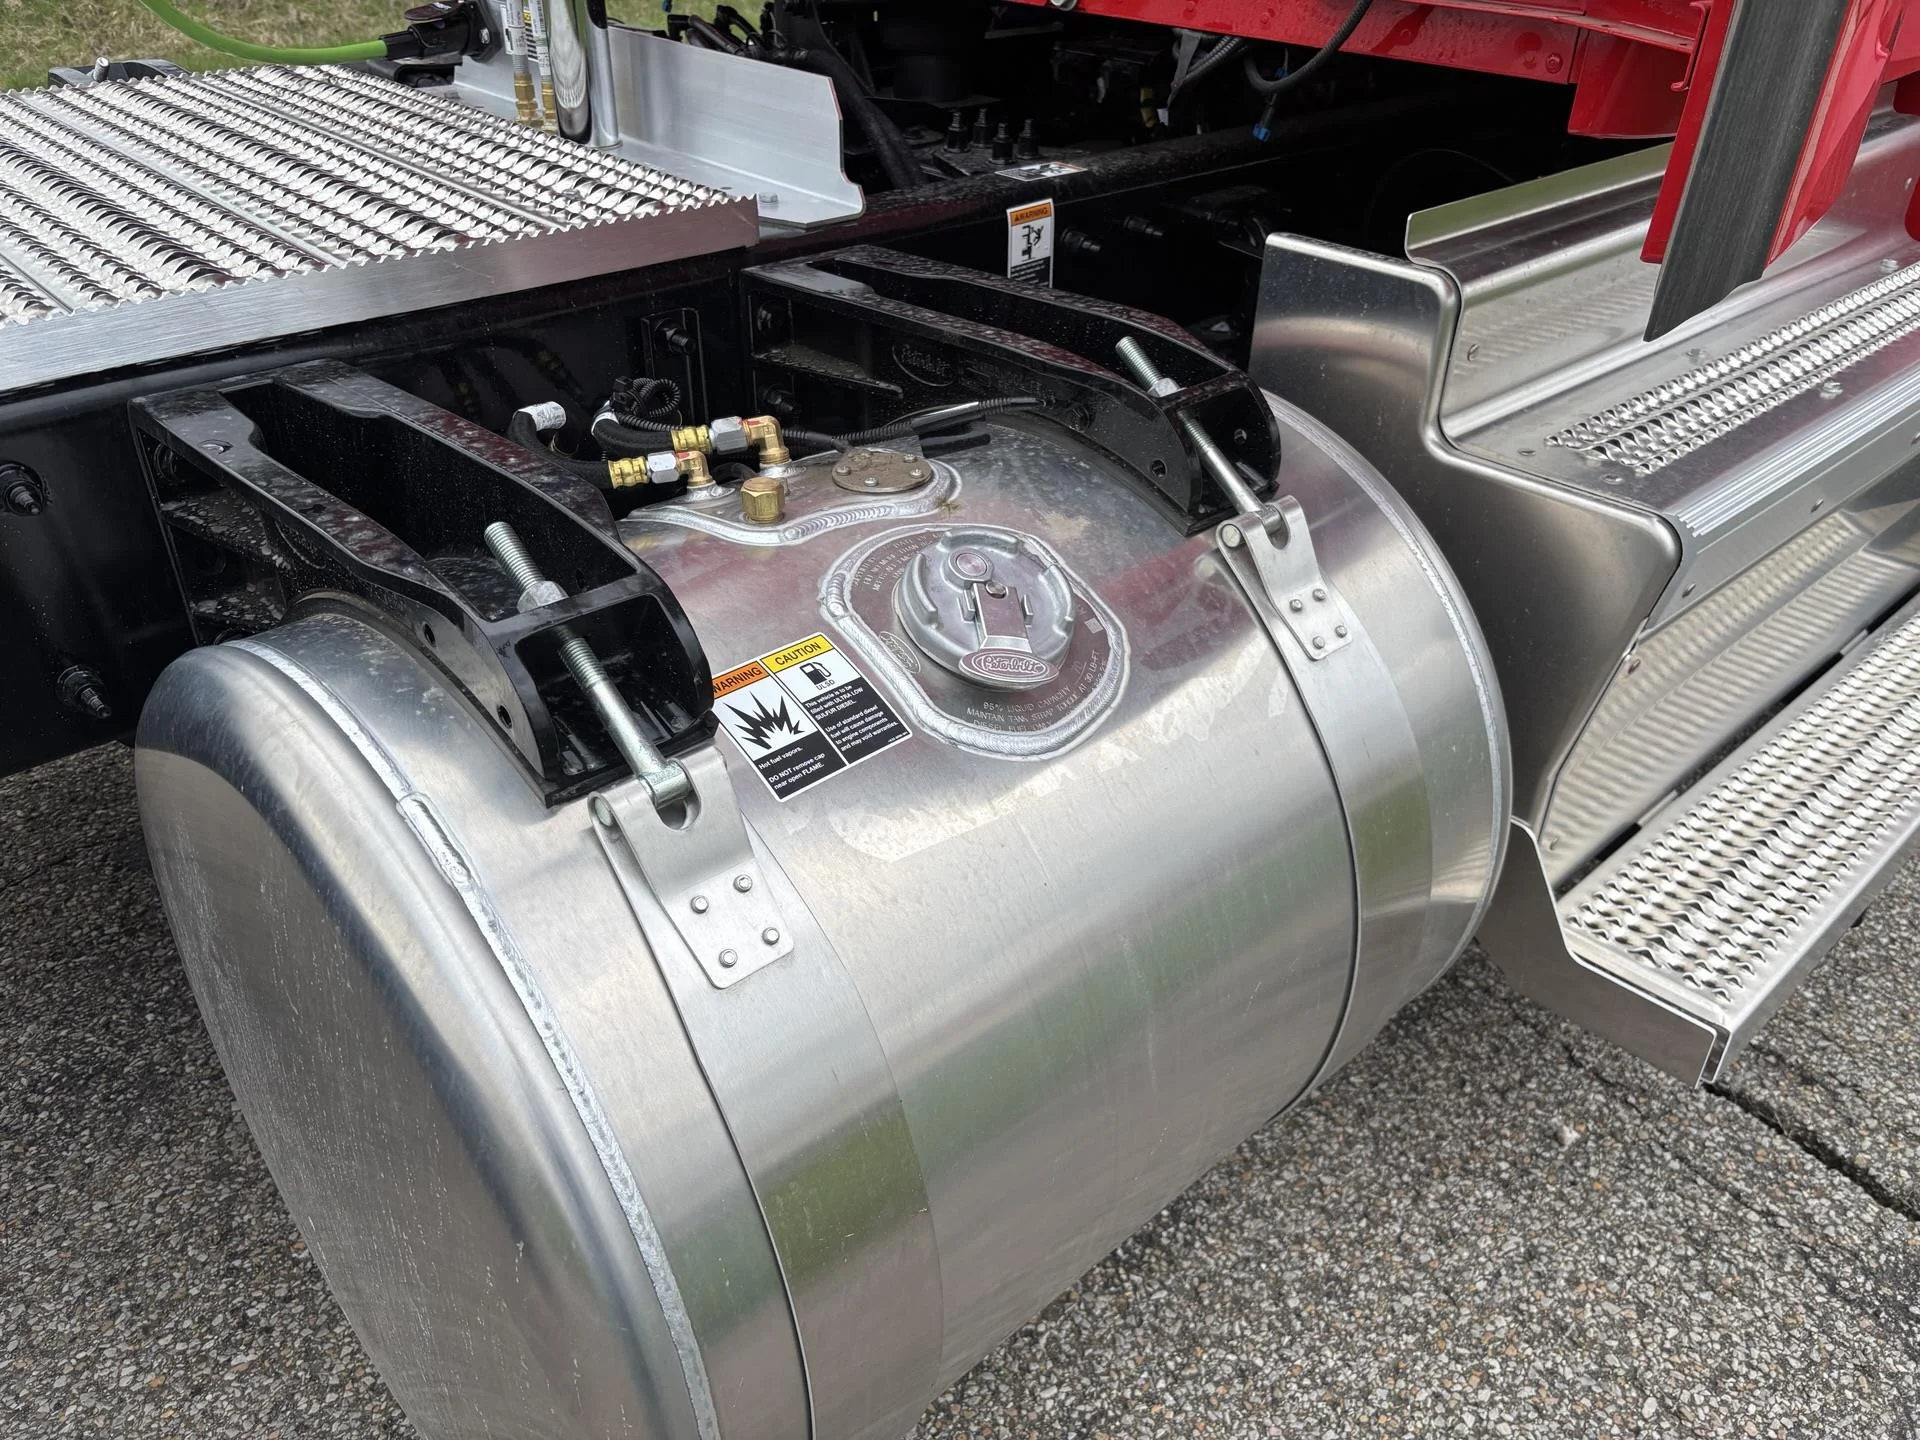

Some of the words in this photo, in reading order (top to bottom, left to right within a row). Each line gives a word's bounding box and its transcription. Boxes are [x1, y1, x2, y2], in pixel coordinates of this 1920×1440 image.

[774, 641, 822, 665] CAUTION
[981, 655, 1040, 673] Peterbilt
[815, 679, 835, 690] ULSD
[817, 693, 835, 703] vehicle
[823, 700, 835, 709] with
[833, 692, 853, 704] ULTRA
[850, 687, 864, 696] LOW
[1007, 703, 1034, 713] LIQUID
[815, 707, 837, 720] SULFUR
[842, 711, 864, 725] standard
[863, 704, 879, 715] diesel
[966, 707, 1005, 722] MAINTAIN
[830, 730, 841, 739] fuel
[849, 720, 865, 730] cause
[864, 711, 884, 723] damage
[842, 731, 859, 742] engine
[858, 717, 888, 734] components
[841, 743, 852, 752] and
[850, 739, 863, 747] may
[861, 732, 873, 741] void
[758, 761, 771, 770] Hot
[769, 755, 782, 765] fuel
[768, 774, 780, 783] DO
[778, 768, 793, 778] NOT
[792, 758, 814, 772] remove
[814, 752, 826, 761] cap
[774, 780, 788, 790] near
[787, 773, 803, 783] open
[801, 761, 825, 776] FLAME.
